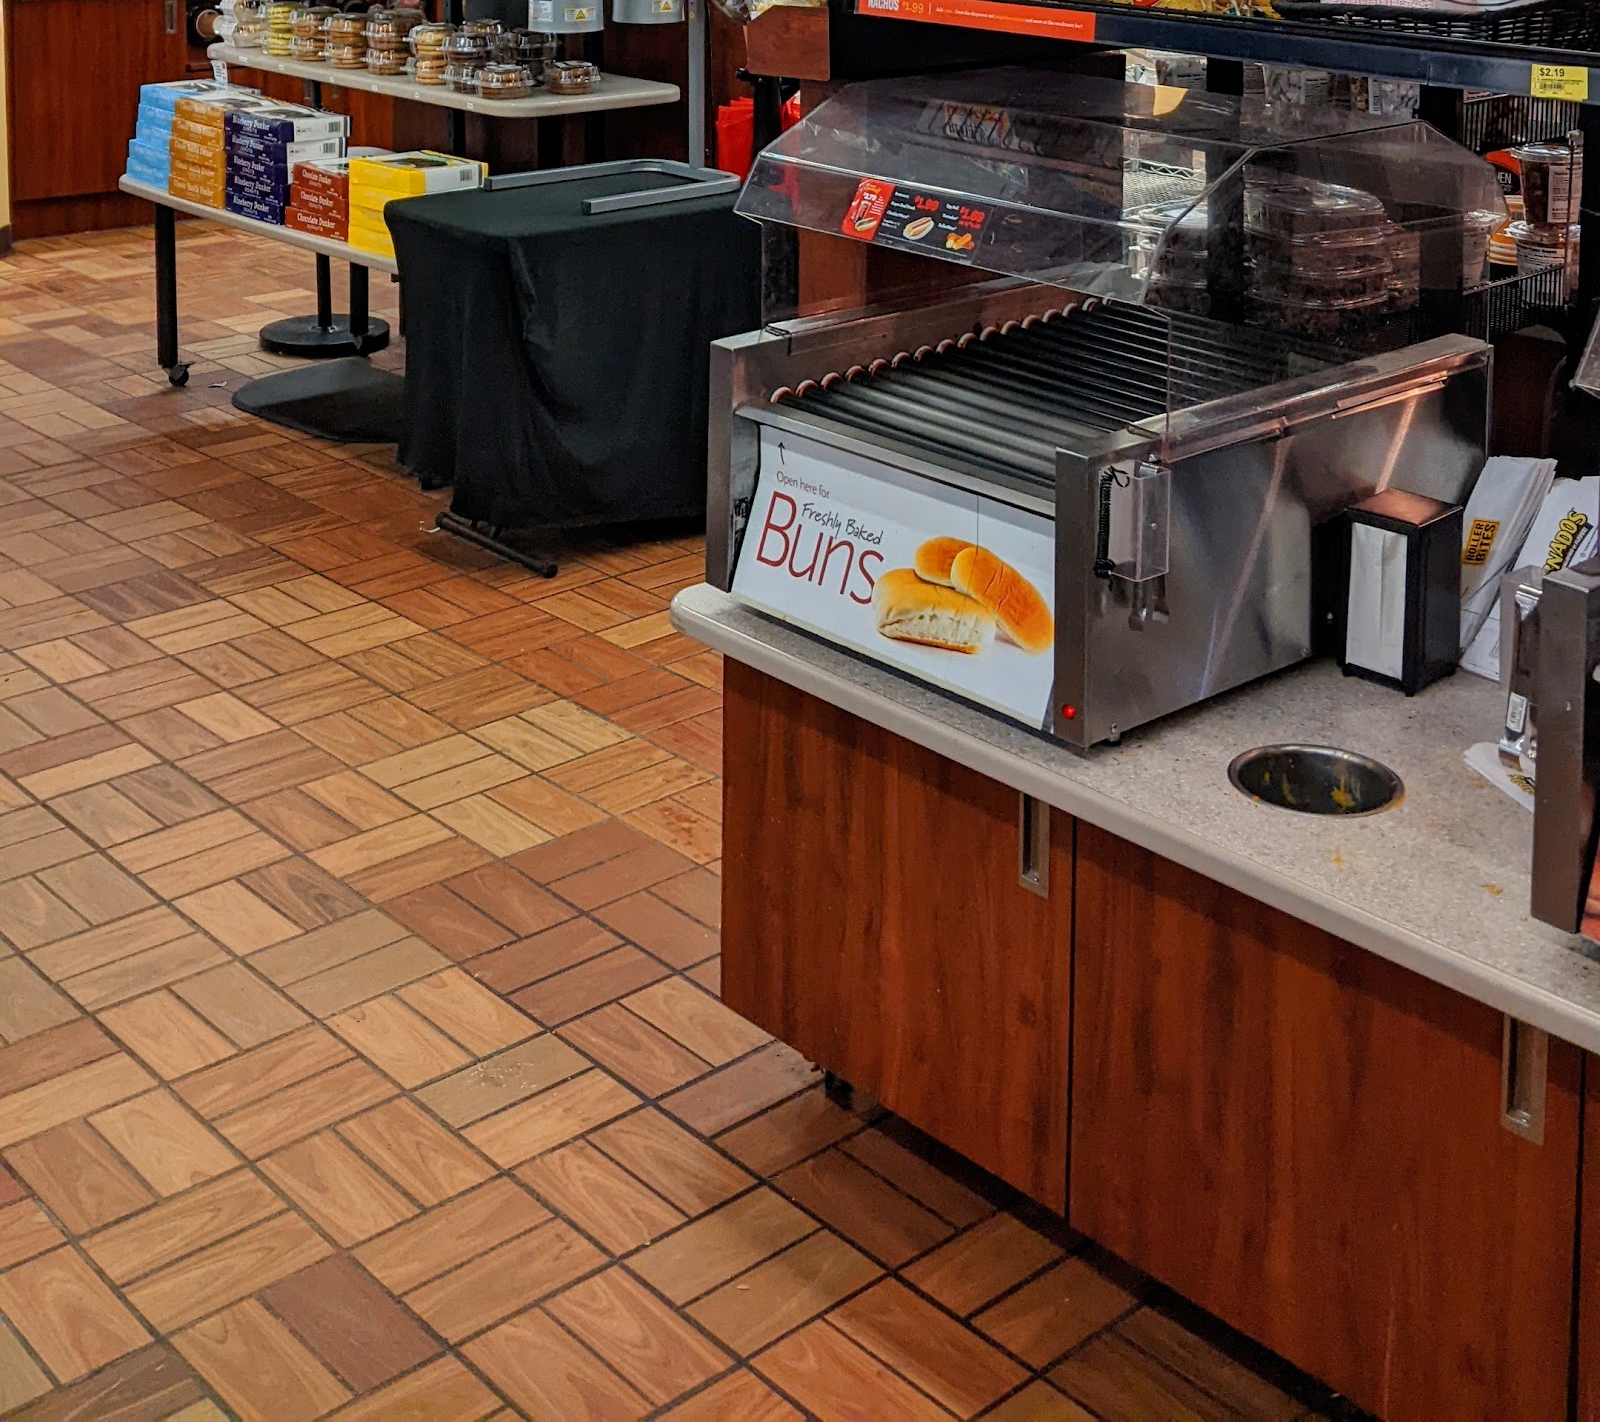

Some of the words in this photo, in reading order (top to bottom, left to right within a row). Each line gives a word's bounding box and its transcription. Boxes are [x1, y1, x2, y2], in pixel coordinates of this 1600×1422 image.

[1540, 68, 1564, 77] $2.19
[254, 201, 270, 212] Dunker
[319, 196, 333, 206] Dunker
[297, 213, 318, 225] Chocolate
[318, 218, 335, 229] Dunker
[776, 471, 798, 488] Open
[799, 478, 817, 495] here
[819, 488, 830, 499] for
[801, 502, 842, 540] Freshly
[845, 519, 884, 545] Baked
[756, 490, 884, 605] Buns
[1467, 522, 1484, 561] ROLLER
[1475, 524, 1496, 561] BITES
[1544, 510, 1588, 572] NADOS
